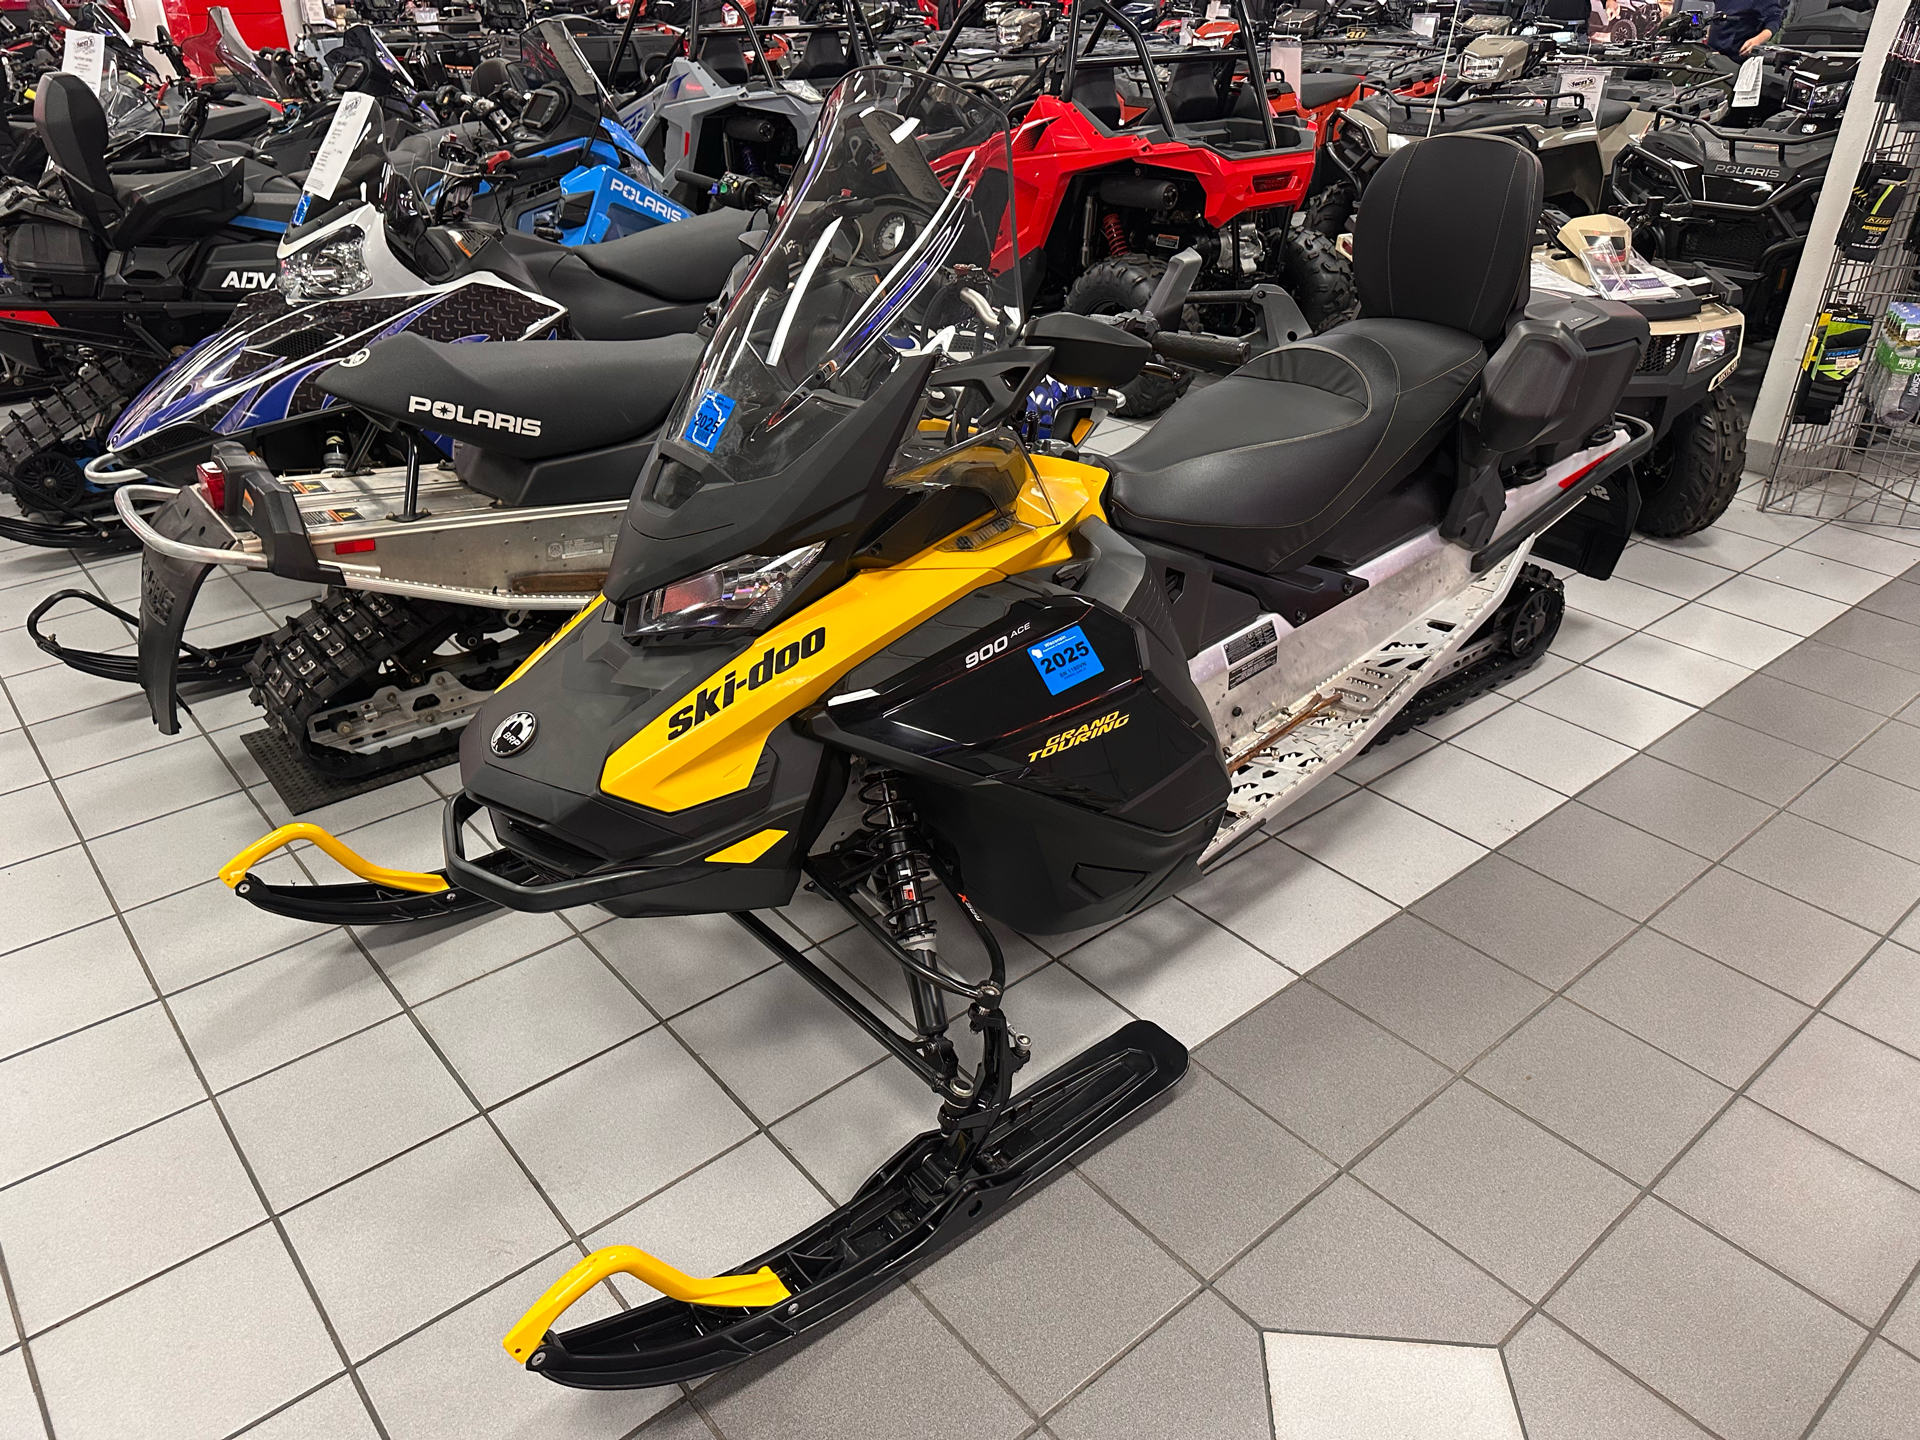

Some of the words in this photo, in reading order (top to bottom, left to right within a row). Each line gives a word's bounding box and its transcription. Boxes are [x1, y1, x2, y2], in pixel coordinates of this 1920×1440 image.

[1714, 164, 1780, 178] POLARIS
[610, 178, 682, 222] POLARIS
[408, 395, 542, 437] POLARIS
[694, 412, 720, 434] 2025
[965, 636, 1008, 669] 900
[1010, 622, 1031, 639] ACE
[1040, 641, 1089, 674] 2025
[1043, 635, 1067, 648] Wisconsin
[502, 731, 521, 746] BRP
[1028, 714, 1130, 763] TOURING
[1046, 711, 1119, 748] GRAND
